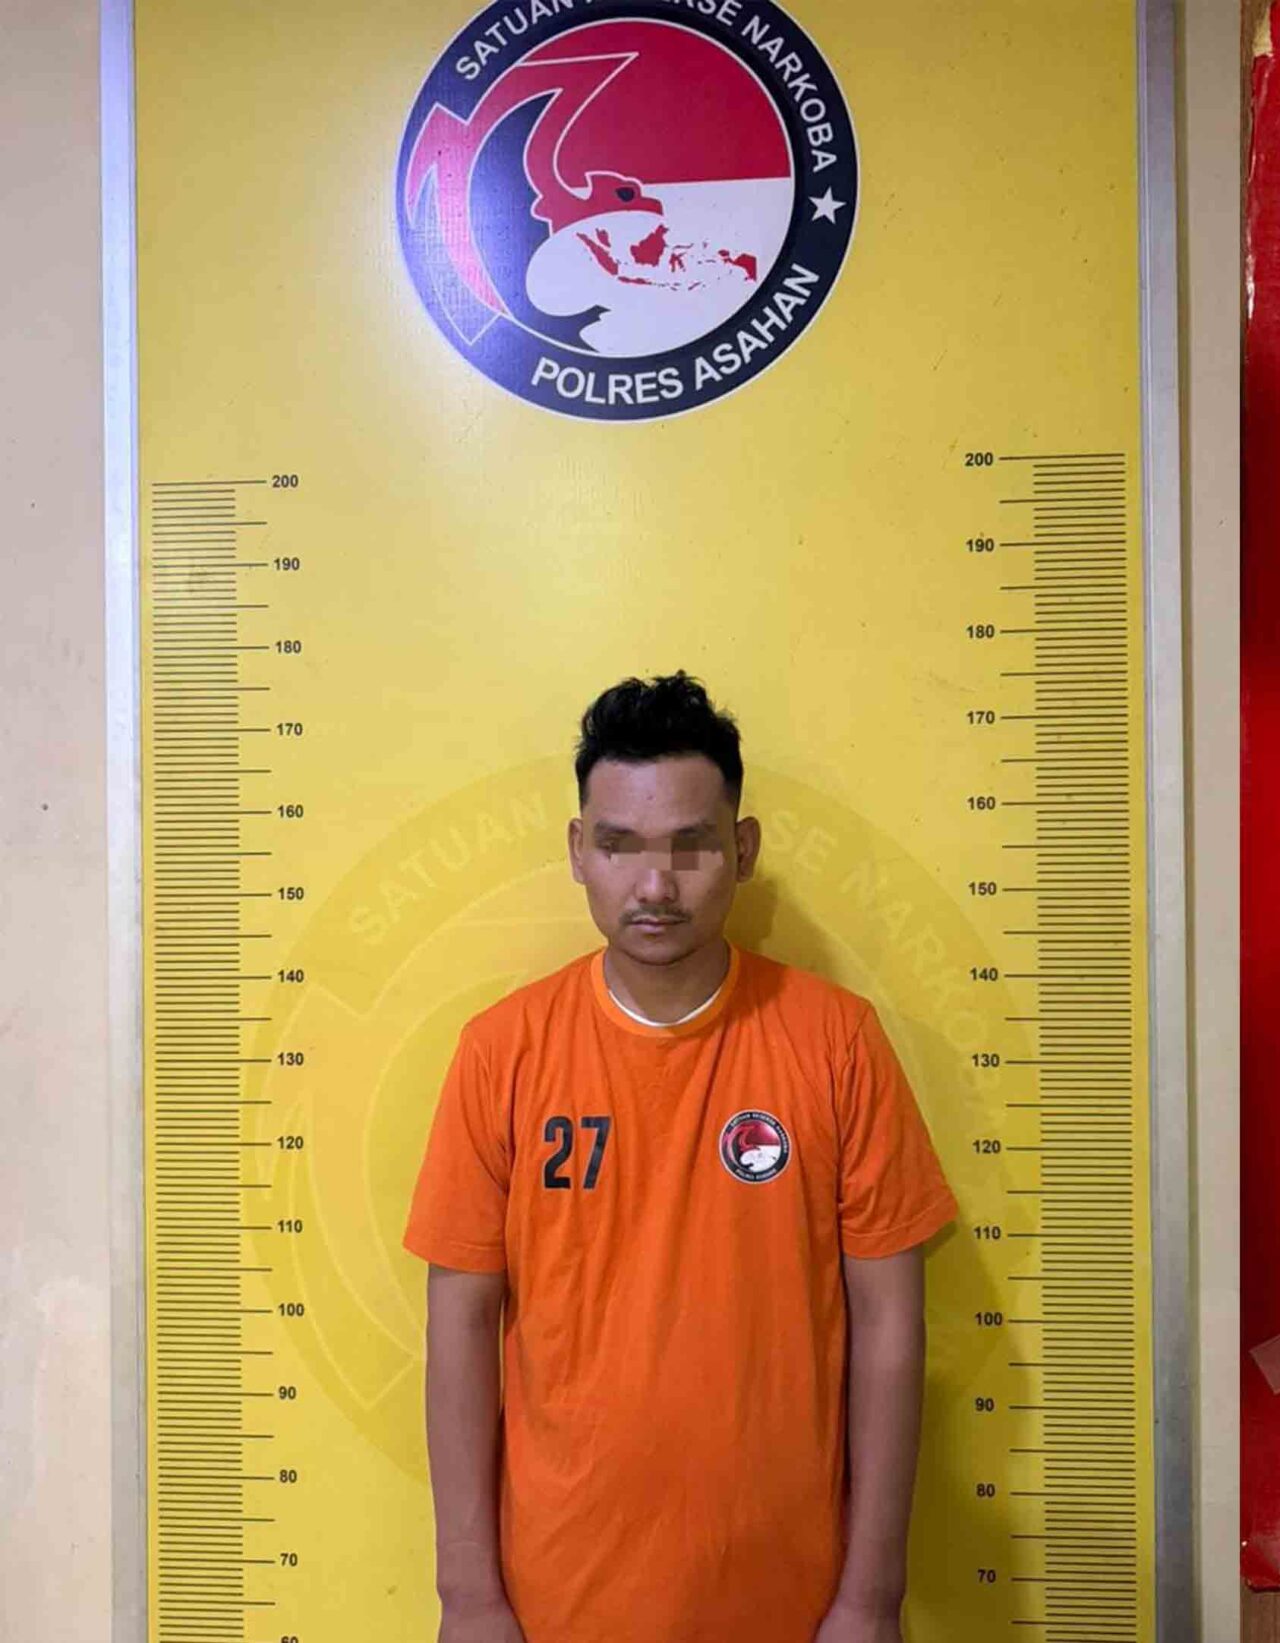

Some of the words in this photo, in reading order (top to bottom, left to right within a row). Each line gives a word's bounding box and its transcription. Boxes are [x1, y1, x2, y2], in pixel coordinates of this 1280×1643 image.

[456, 0, 575, 80] SATUAN
[741, 14, 838, 173] NARKOBA
[531, 357, 684, 405] POLRES
[694, 263, 820, 391] ASAHAN
[964, 451, 994, 467] 200
[272, 474, 299, 489] 200
[966, 538, 995, 553] 190
[273, 557, 300, 571] 190
[966, 624, 995, 639] 180
[275, 640, 302, 654] 180
[967, 710, 996, 725] 170
[276, 722, 304, 736] 170
[277, 804, 304, 818] 160
[967, 796, 996, 811] 160
[278, 886, 305, 901] 150
[968, 881, 997, 896] 150
[278, 969, 304, 983] 140
[970, 967, 999, 982] 140
[277, 1052, 305, 1066] 130
[971, 1053, 1000, 1068] 130
[277, 1135, 304, 1150] 120
[972, 1139, 1001, 1154] 120
[543, 1115, 611, 1190] 27
[277, 1219, 303, 1234] 110
[973, 1226, 1002, 1240] 110
[278, 1302, 305, 1317] 100
[975, 1311, 1003, 1327] 100
[278, 1385, 297, 1400] 90
[975, 1396, 995, 1413] 90
[279, 1469, 298, 1484] 80
[976, 1483, 996, 1498] 80
[280, 1552, 298, 1567] 70
[977, 1568, 997, 1584] 70
